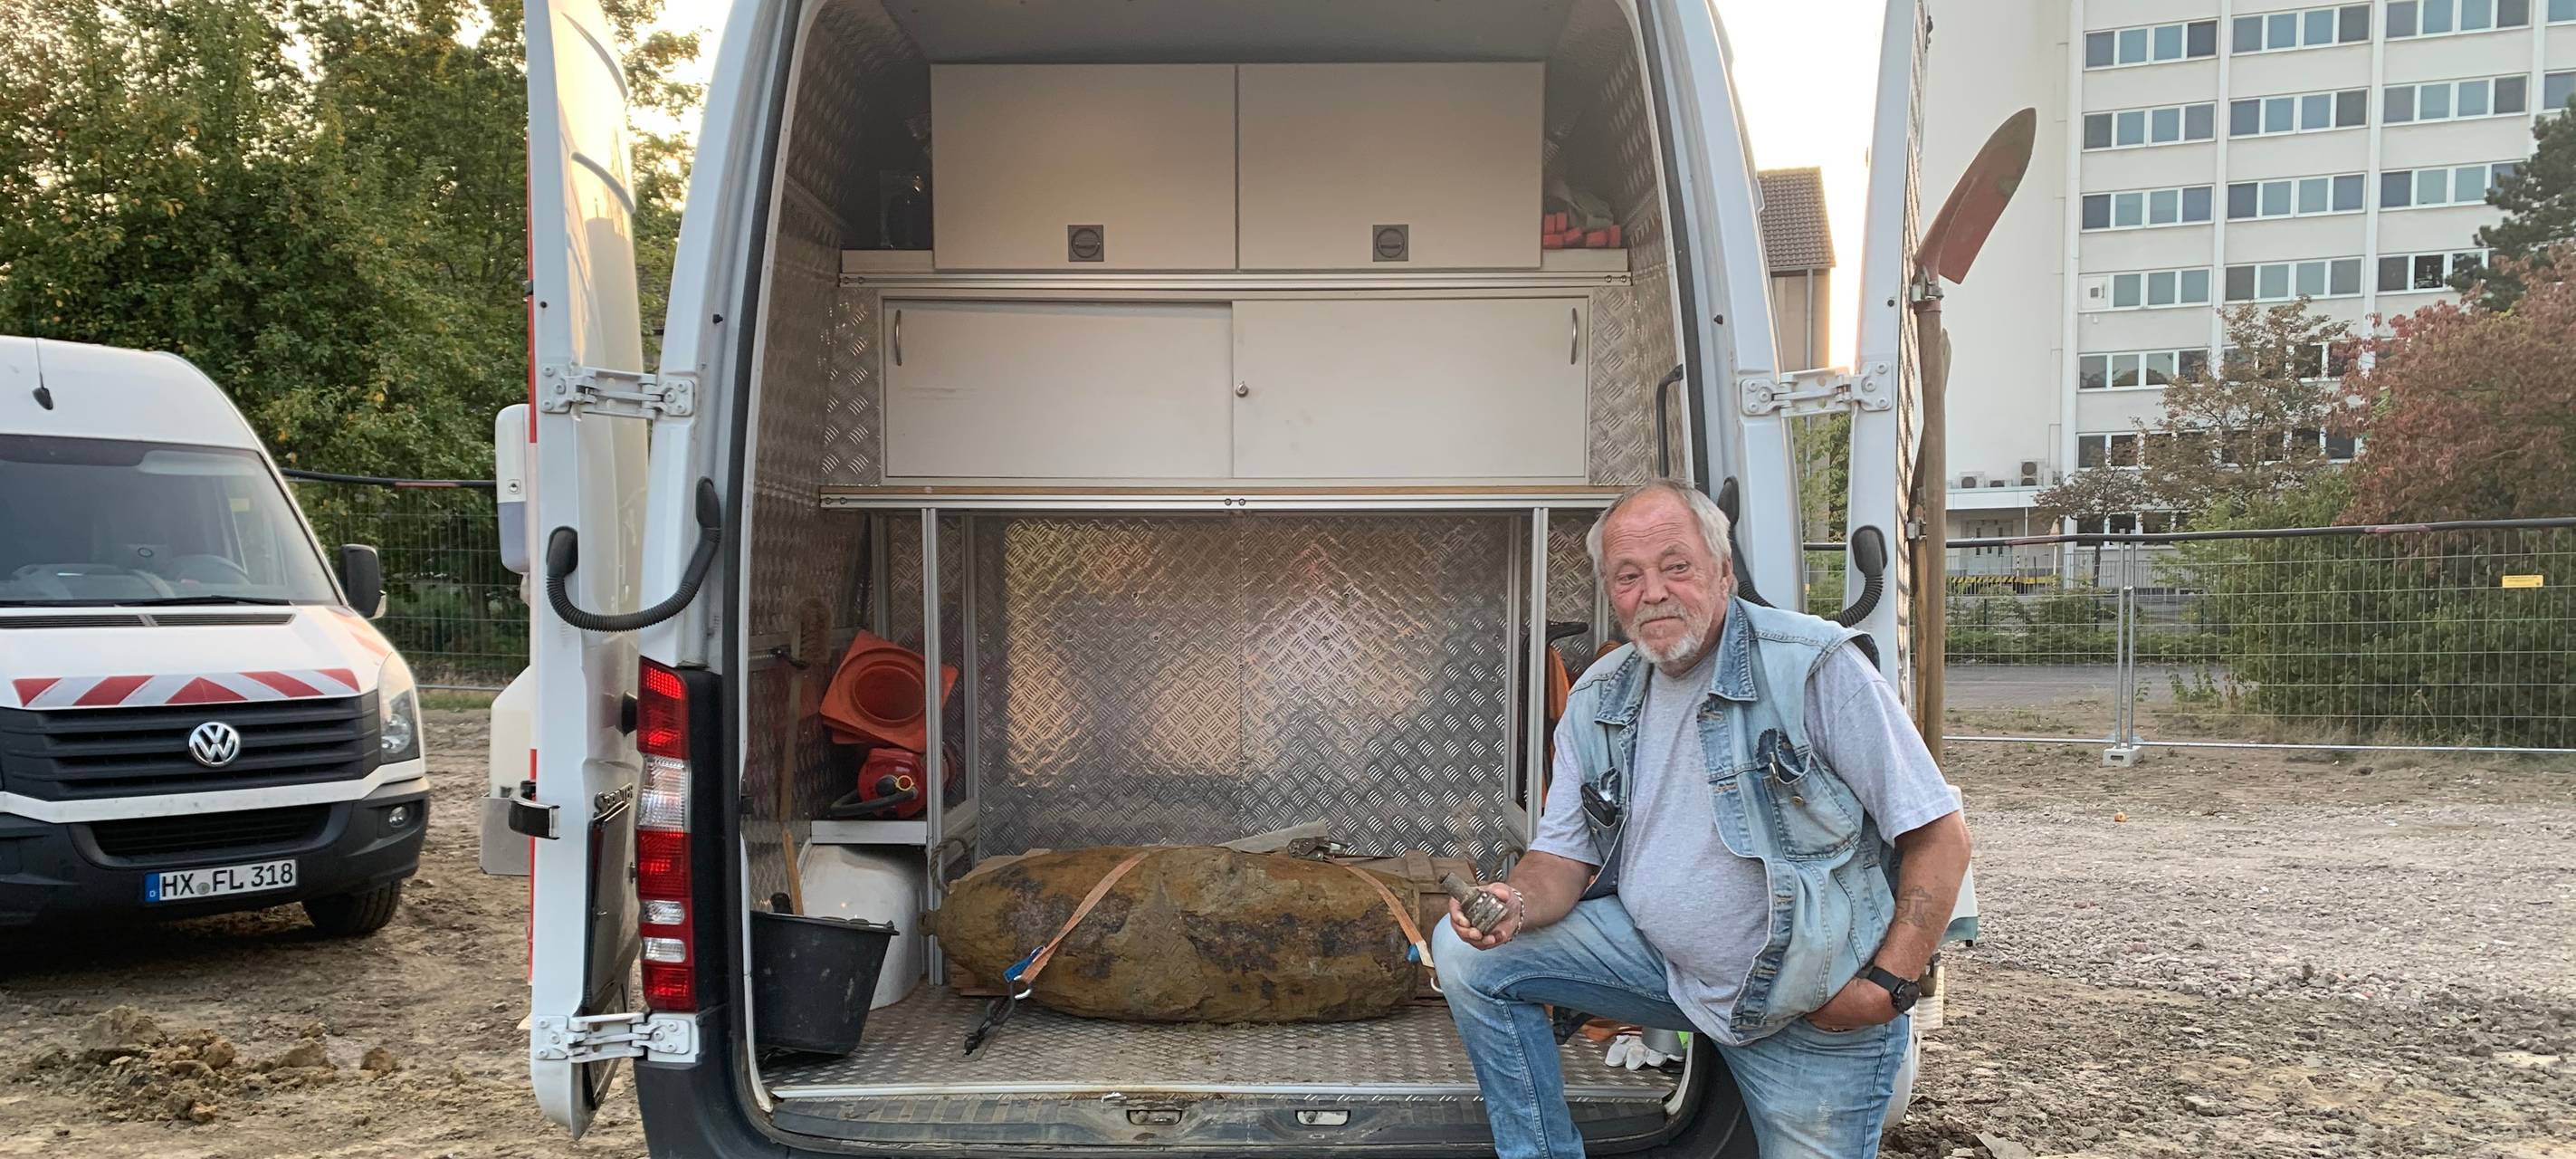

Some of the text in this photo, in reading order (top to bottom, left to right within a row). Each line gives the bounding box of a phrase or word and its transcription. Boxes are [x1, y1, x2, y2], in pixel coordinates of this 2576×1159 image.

[190, 723, 238, 764] VW
[149, 863, 293, 898] D HX FL 318
